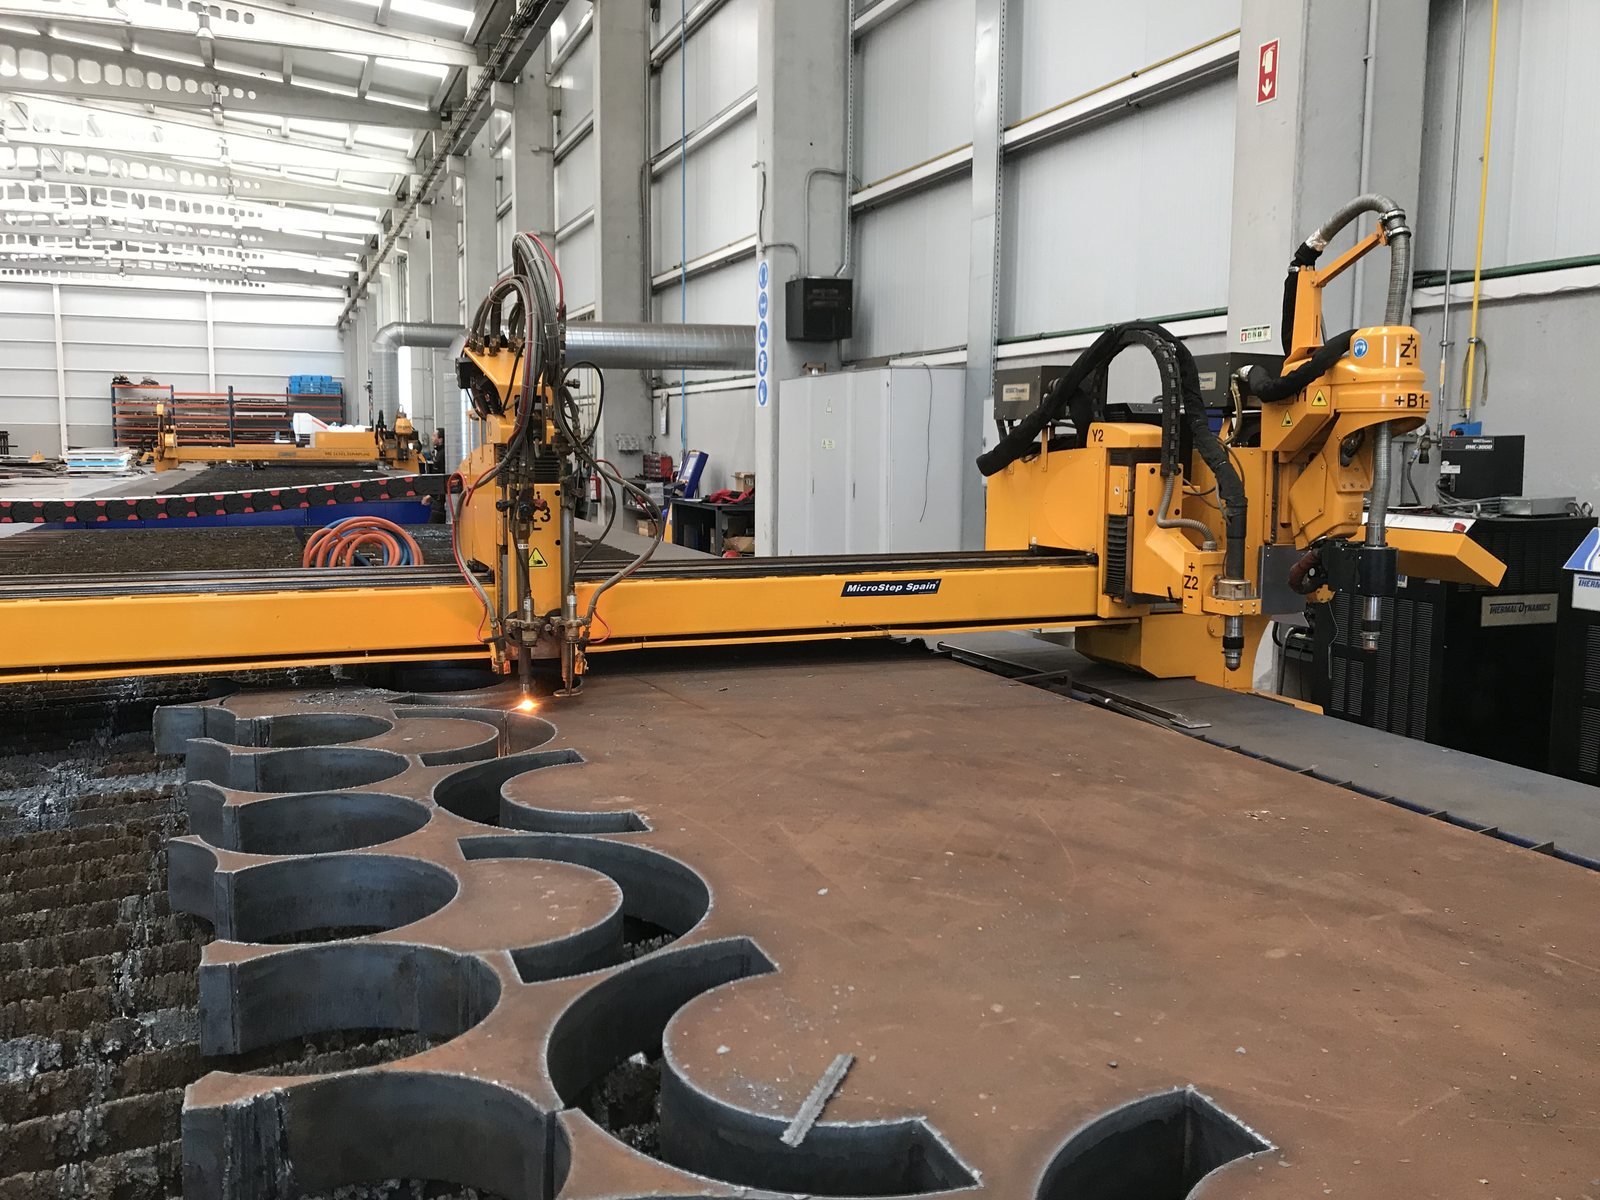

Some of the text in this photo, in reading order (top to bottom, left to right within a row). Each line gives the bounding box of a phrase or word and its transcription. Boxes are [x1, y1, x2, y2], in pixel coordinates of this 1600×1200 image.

[1400, 343, 1417, 358] Z1
[1092, 429, 1103, 442] Y2
[846, 581, 936, 592] MicroStep Spain
[1183, 574, 1199, 590] Z2
[1489, 602, 1551, 614] THERMAL DYNAMICS
